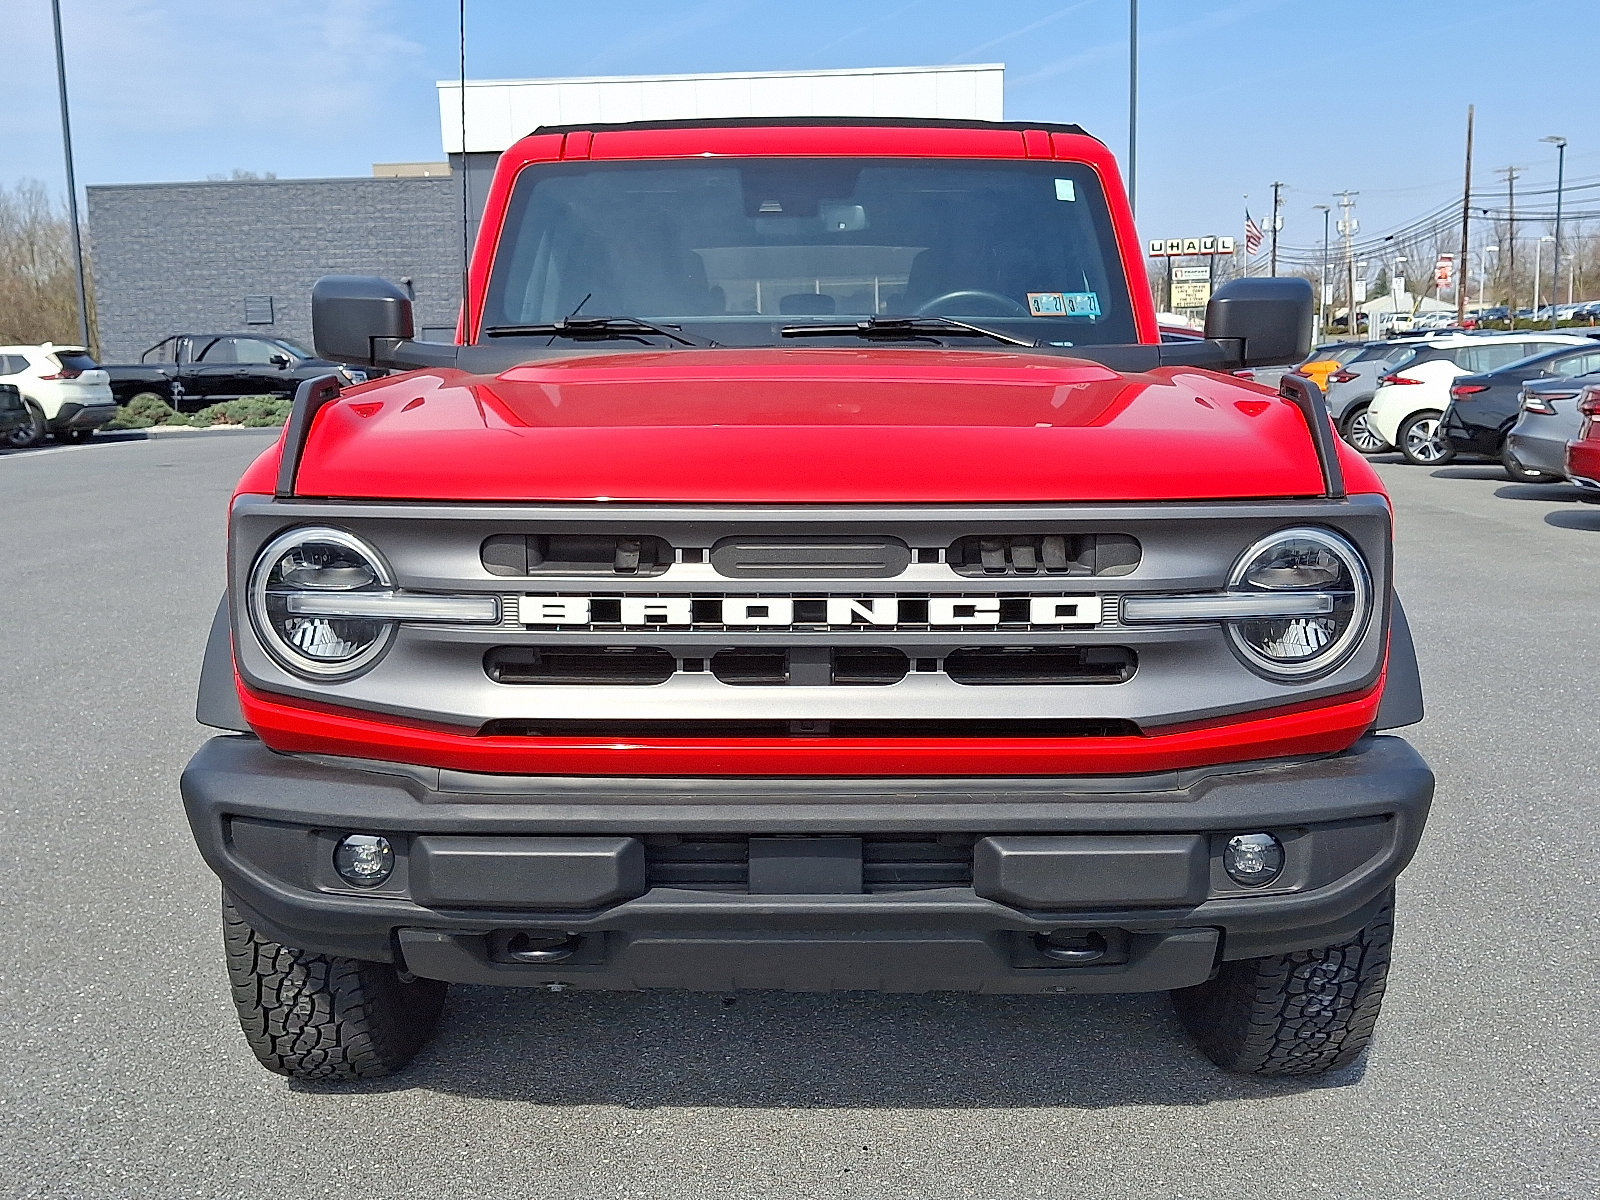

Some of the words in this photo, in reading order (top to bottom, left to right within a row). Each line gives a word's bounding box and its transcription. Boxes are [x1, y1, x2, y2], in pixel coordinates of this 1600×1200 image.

[1151, 240, 1231, 252] UHAUL
[1033, 299, 1041, 313] 3
[1068, 299, 1076, 313] 3
[519, 596, 1102, 625] BRONCO
